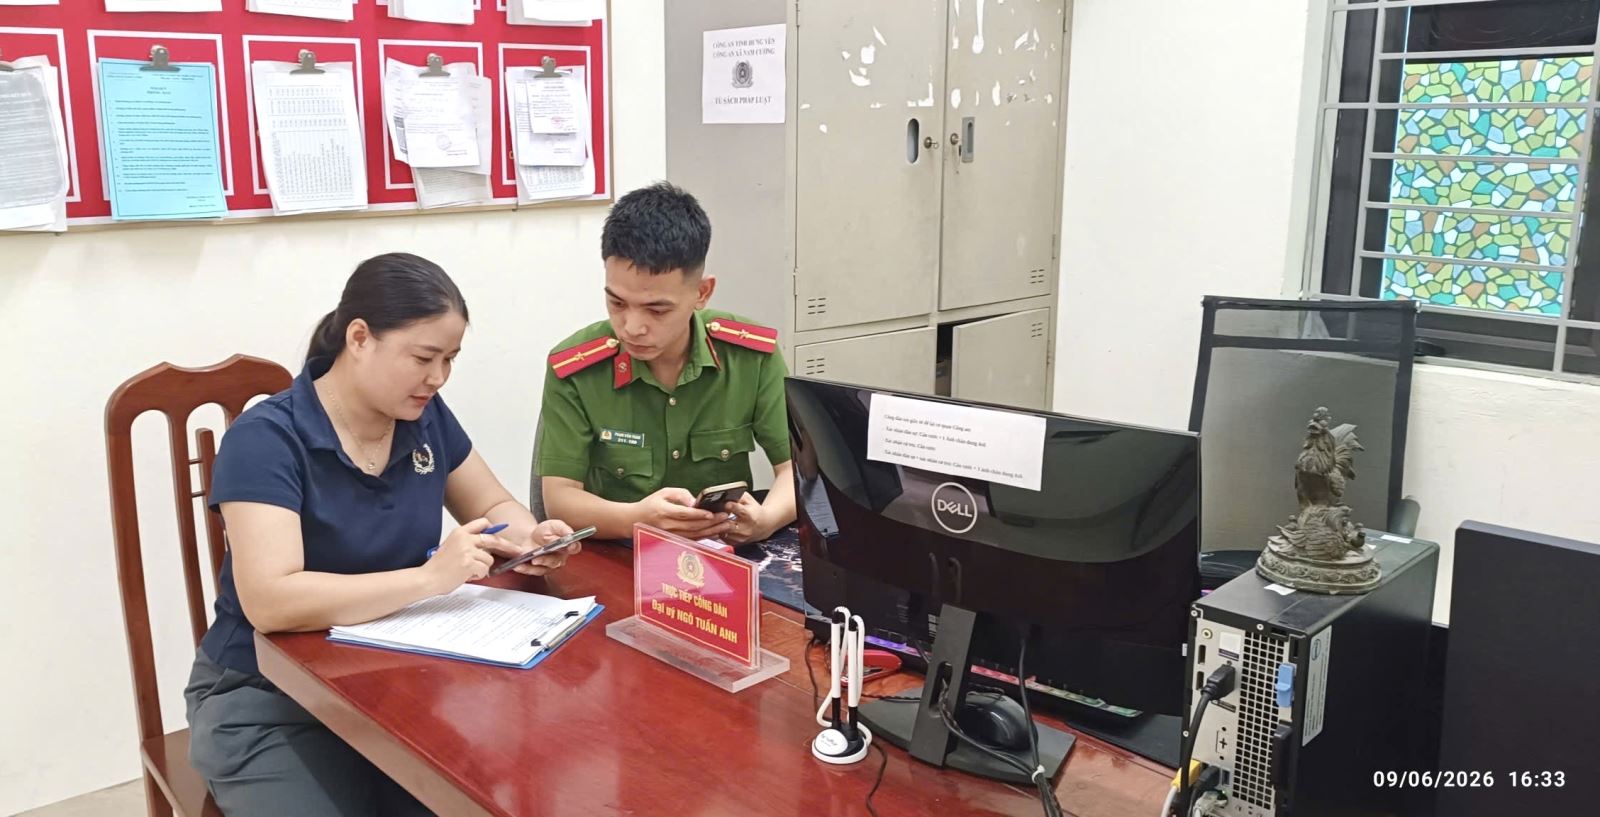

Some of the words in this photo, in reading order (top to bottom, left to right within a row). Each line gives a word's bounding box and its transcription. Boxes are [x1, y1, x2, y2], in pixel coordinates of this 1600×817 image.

[937, 499, 973, 518] DELL
[662, 582, 679, 599] TRỰC
[678, 588, 693, 604] TIẾP
[693, 594, 713, 612] CÔNG
[713, 602, 728, 618] DÂN
[651, 598, 665, 616] Đại
[676, 609, 694, 625] NGÔ
[695, 616, 718, 636] TUẤN
[719, 626, 738, 644] ANH
